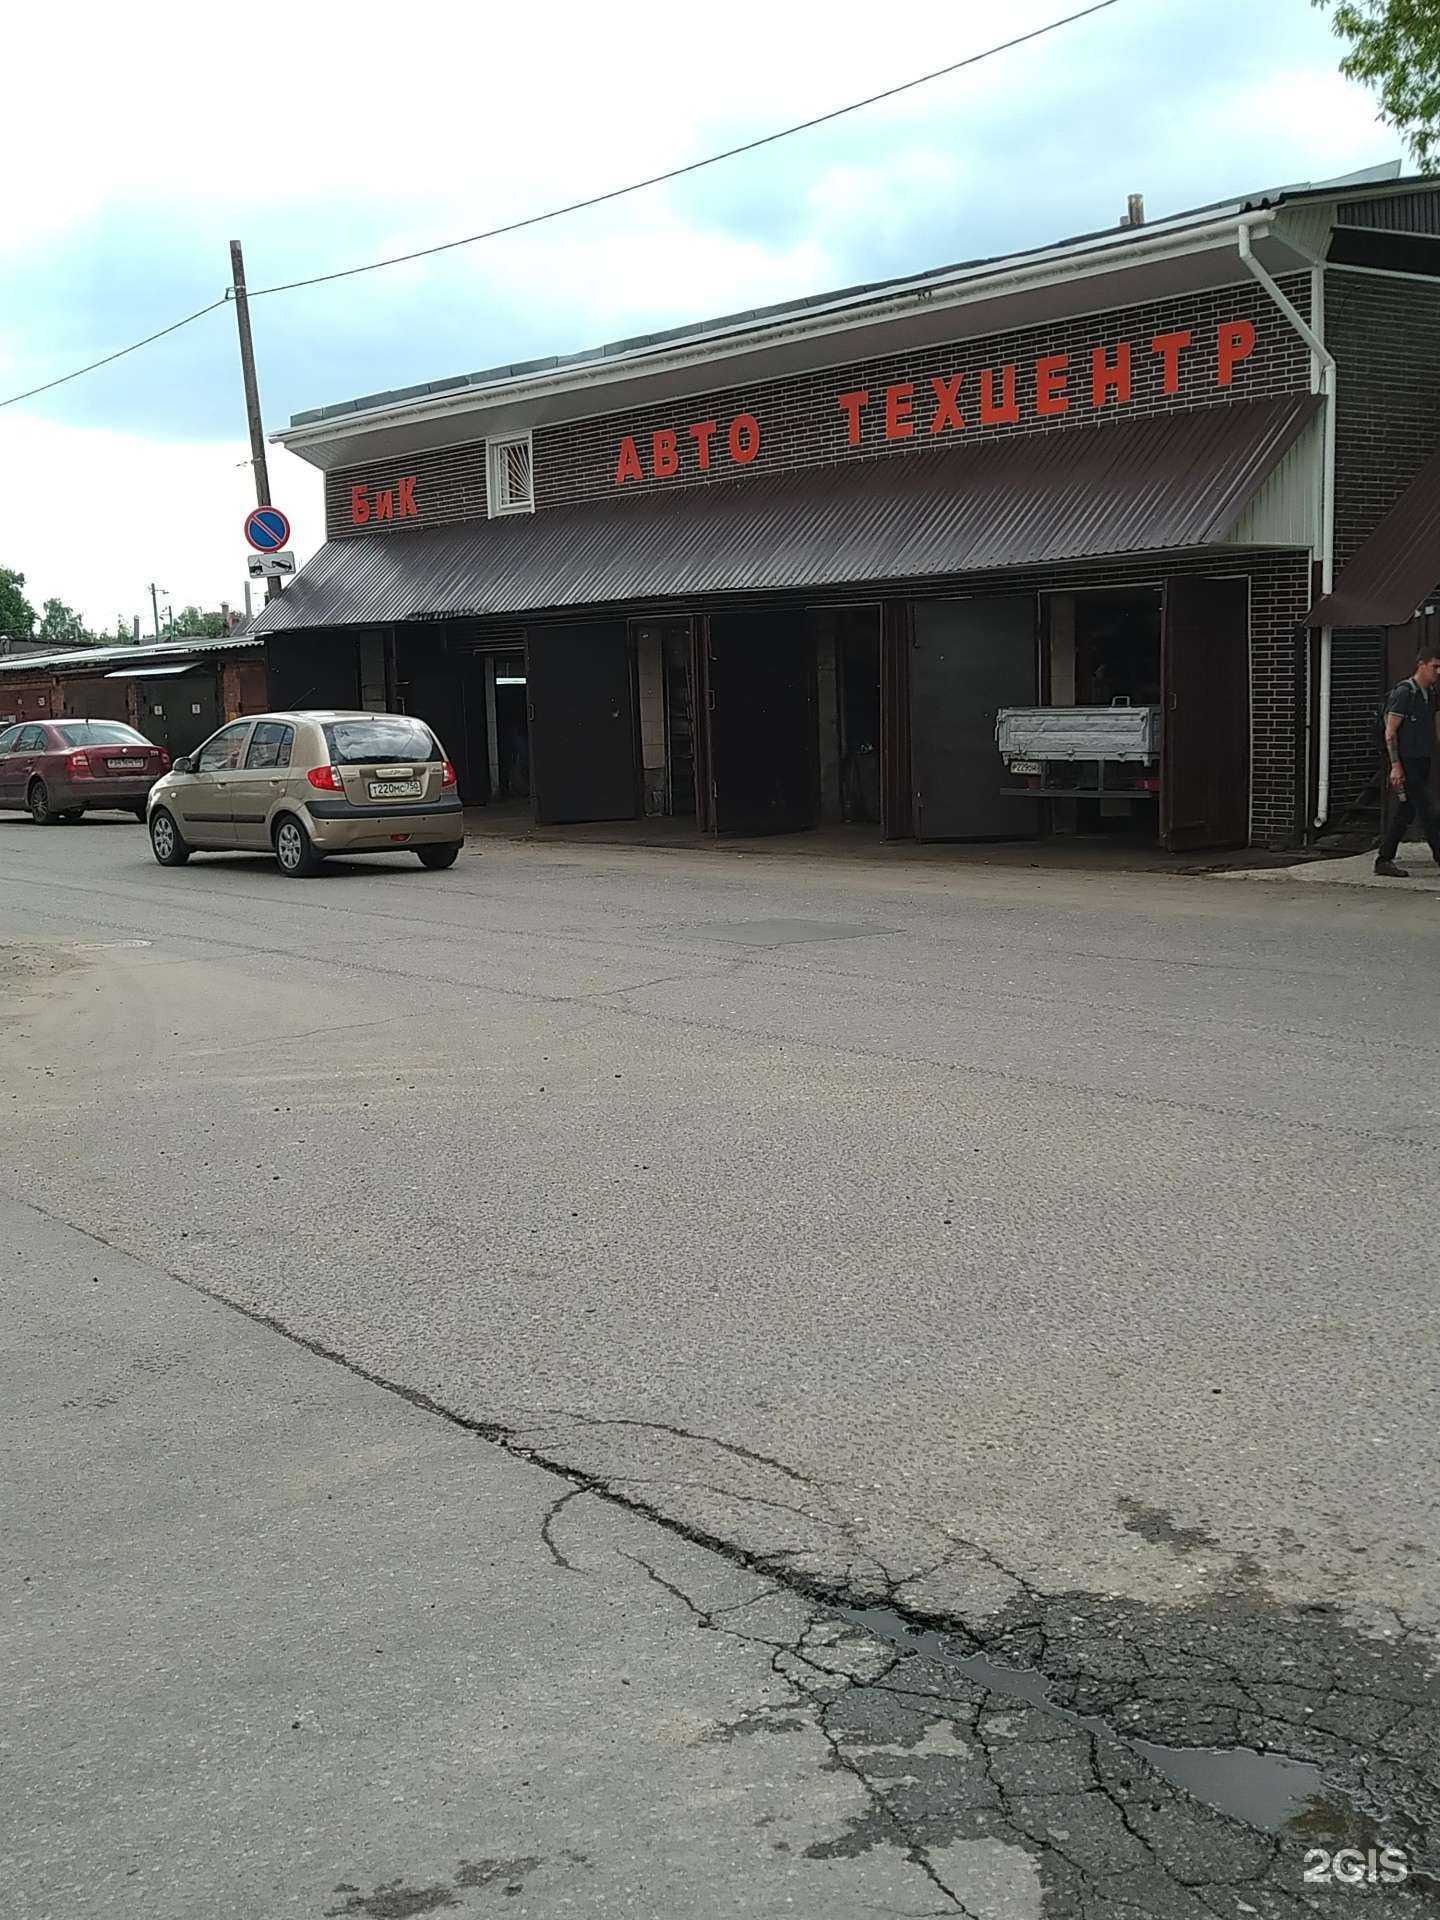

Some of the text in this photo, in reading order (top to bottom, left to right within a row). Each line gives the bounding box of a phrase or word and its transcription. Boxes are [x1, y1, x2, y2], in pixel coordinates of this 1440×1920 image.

[614, 319, 1257, 485] АВТО ТЕХЦЕНТР
[351, 475, 418, 524] БиК
